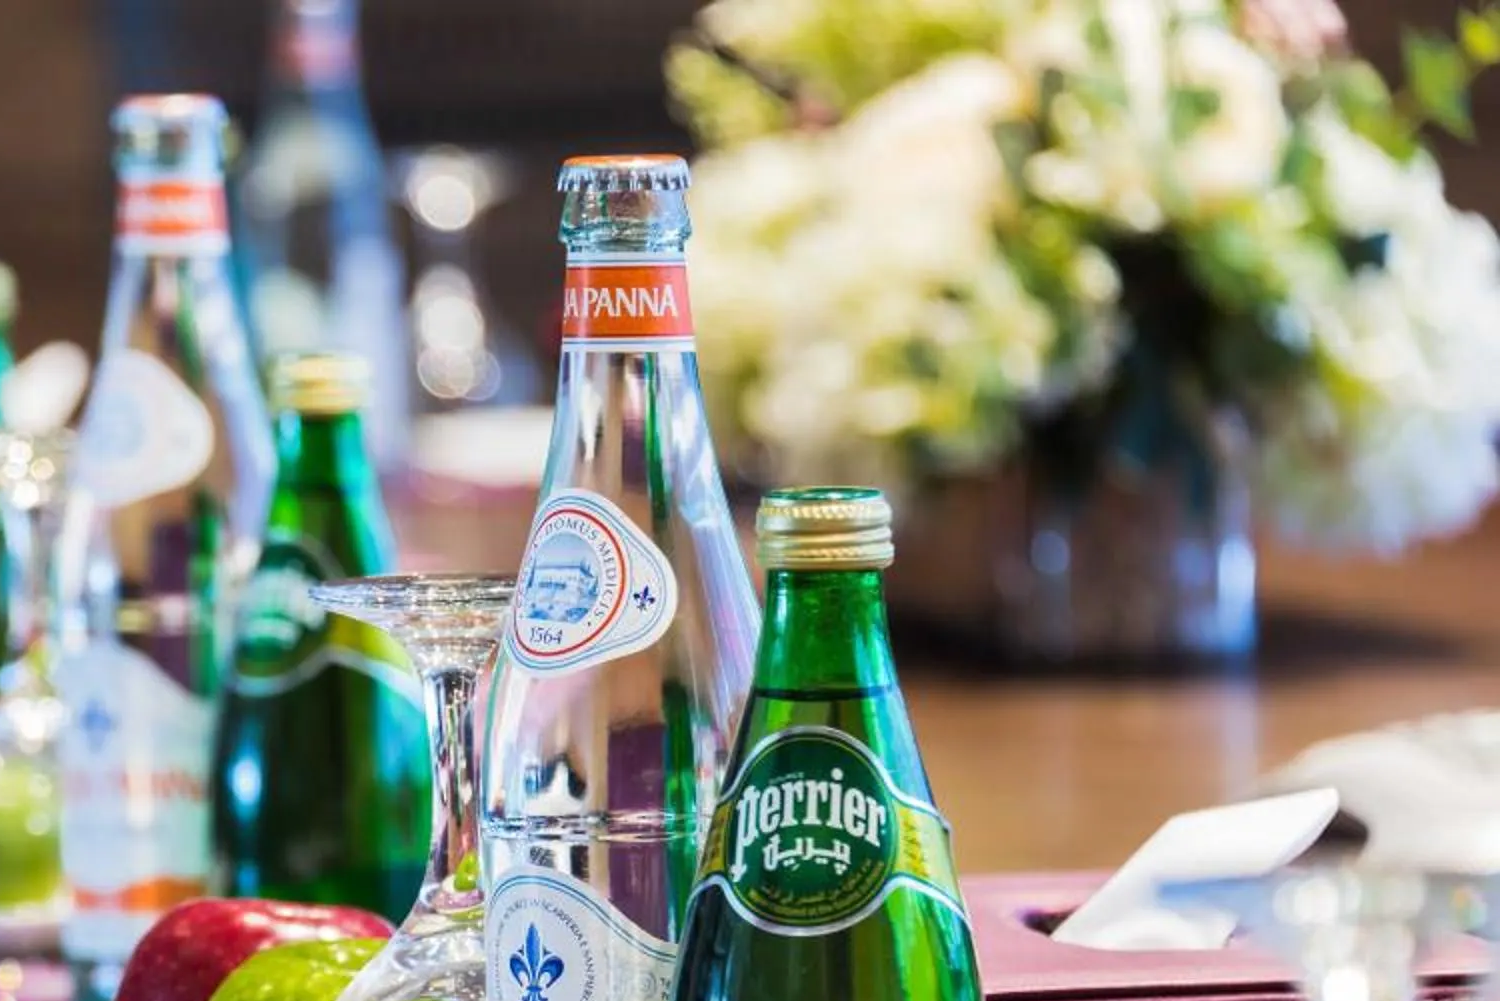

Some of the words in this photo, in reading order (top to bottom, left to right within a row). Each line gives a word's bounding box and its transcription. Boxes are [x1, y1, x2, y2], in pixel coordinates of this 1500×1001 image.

[581, 284, 679, 318] PANNA
[544, 516, 601, 542] DOMUS
[596, 542, 618, 618] MEDICIS
[529, 626, 563, 645] 1564
[731, 767, 886, 883] perrier
